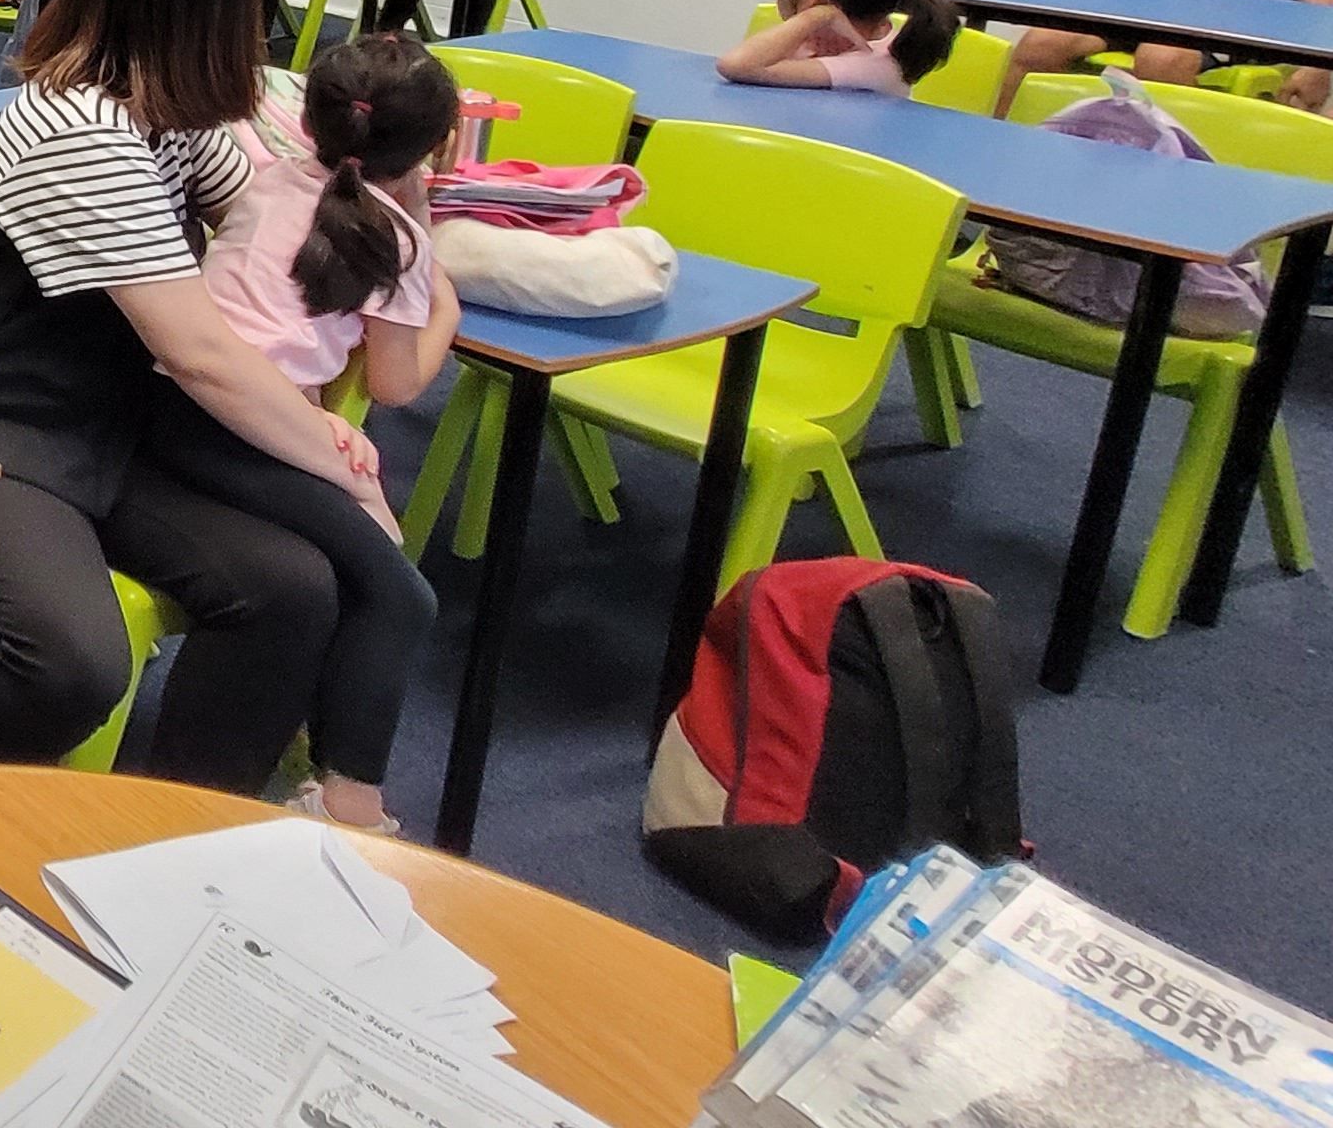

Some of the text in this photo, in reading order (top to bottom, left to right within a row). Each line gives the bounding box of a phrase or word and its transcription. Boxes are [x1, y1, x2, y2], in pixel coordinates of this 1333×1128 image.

[1010, 924, 1268, 1066] HISTORY
[1025, 911, 1278, 1055] MODERN
[1094, 933, 1241, 1015] FEATURES
[364, 1014, 403, 1040] Field
[406, 1038, 460, 1072] System
